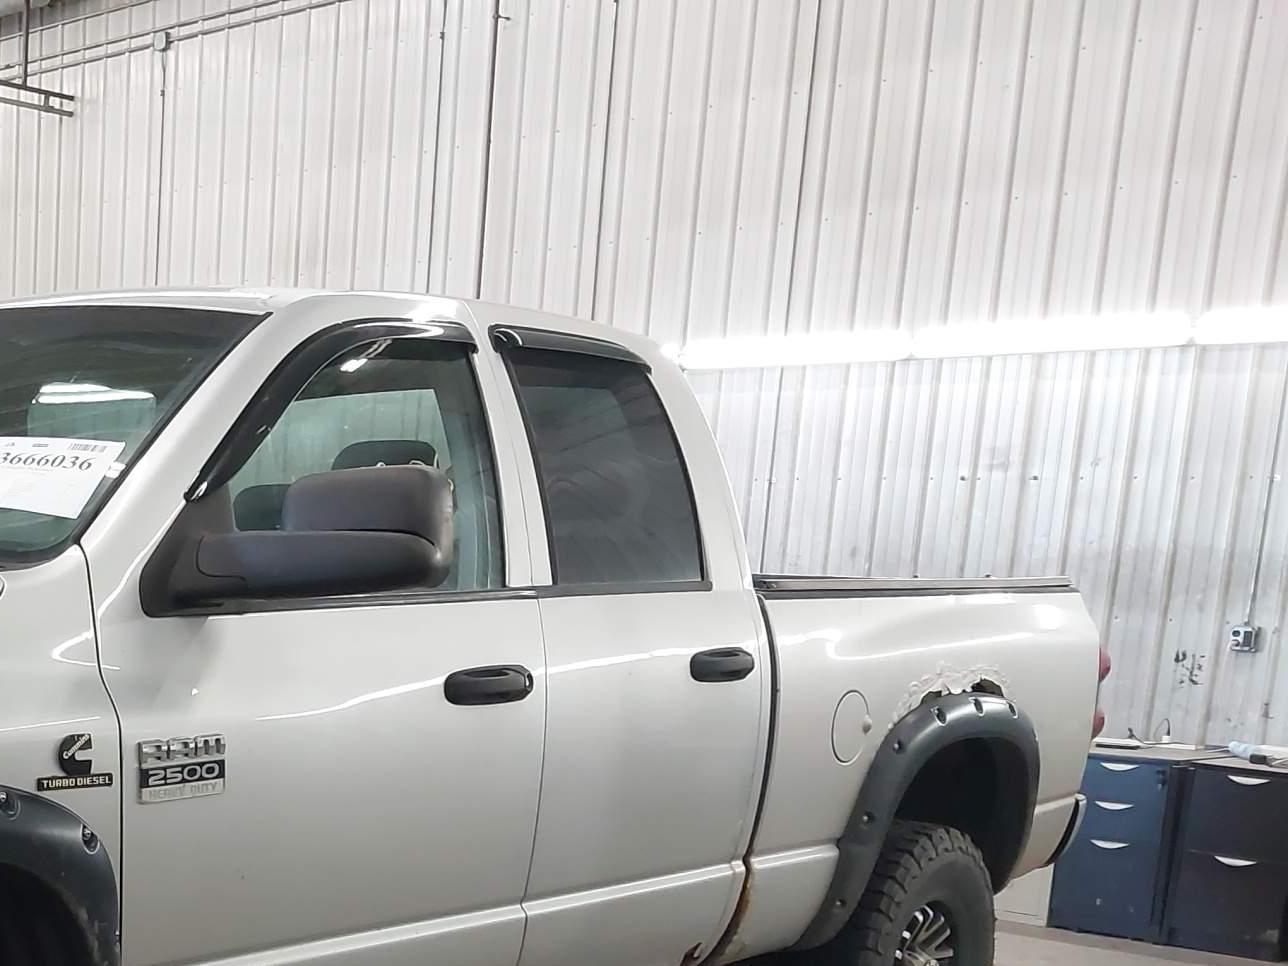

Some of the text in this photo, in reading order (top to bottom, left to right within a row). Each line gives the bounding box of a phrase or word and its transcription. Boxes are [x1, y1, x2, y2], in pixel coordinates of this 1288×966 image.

[62, 733, 90, 760] Cummins
[137, 733, 226, 764] RAM
[42, 774, 112, 789] TURBO DIESEL
[148, 762, 220, 786] 2500
[189, 781, 218, 794] DUTY
